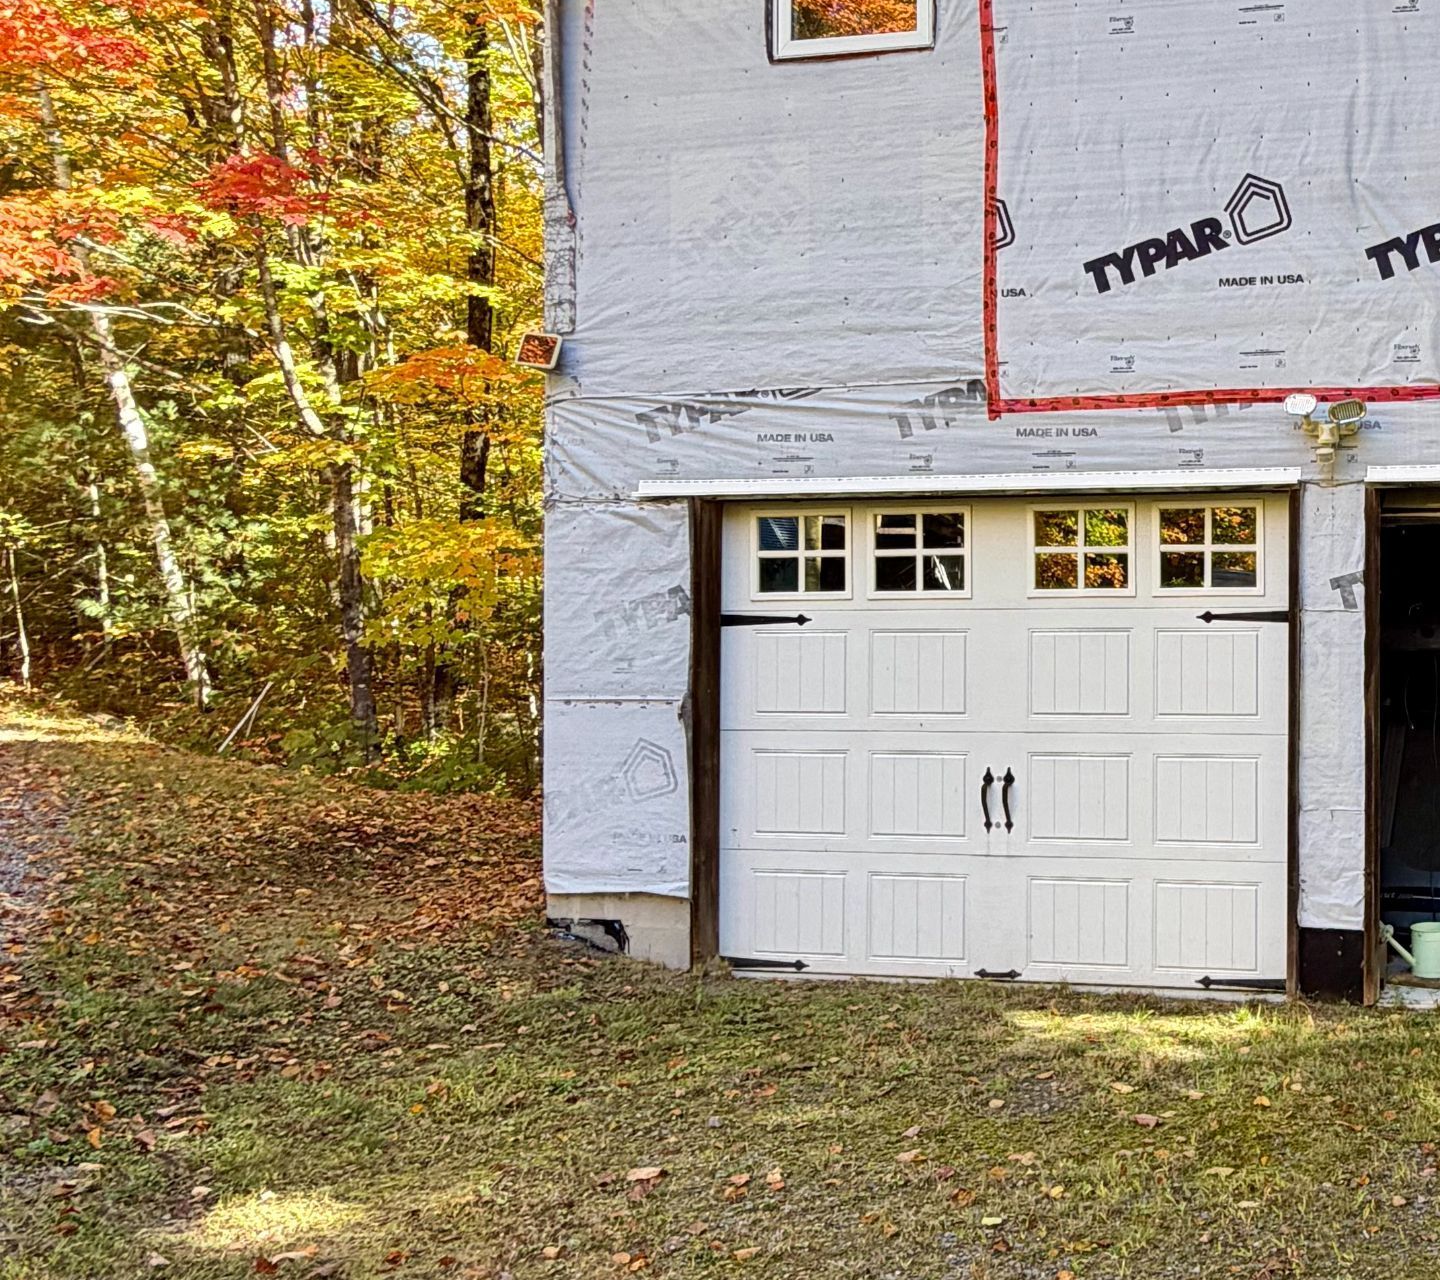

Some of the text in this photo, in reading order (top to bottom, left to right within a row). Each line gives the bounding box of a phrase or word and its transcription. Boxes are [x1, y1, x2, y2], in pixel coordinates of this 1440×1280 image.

[1083, 217, 1230, 293] TYPAR
[1218, 274, 1305, 287] MADE IN USA
[1001, 288, 1026, 297] USA
[757, 433, 834, 444] MADE IN USA
[1016, 427, 1098, 439] MADE IN USA
